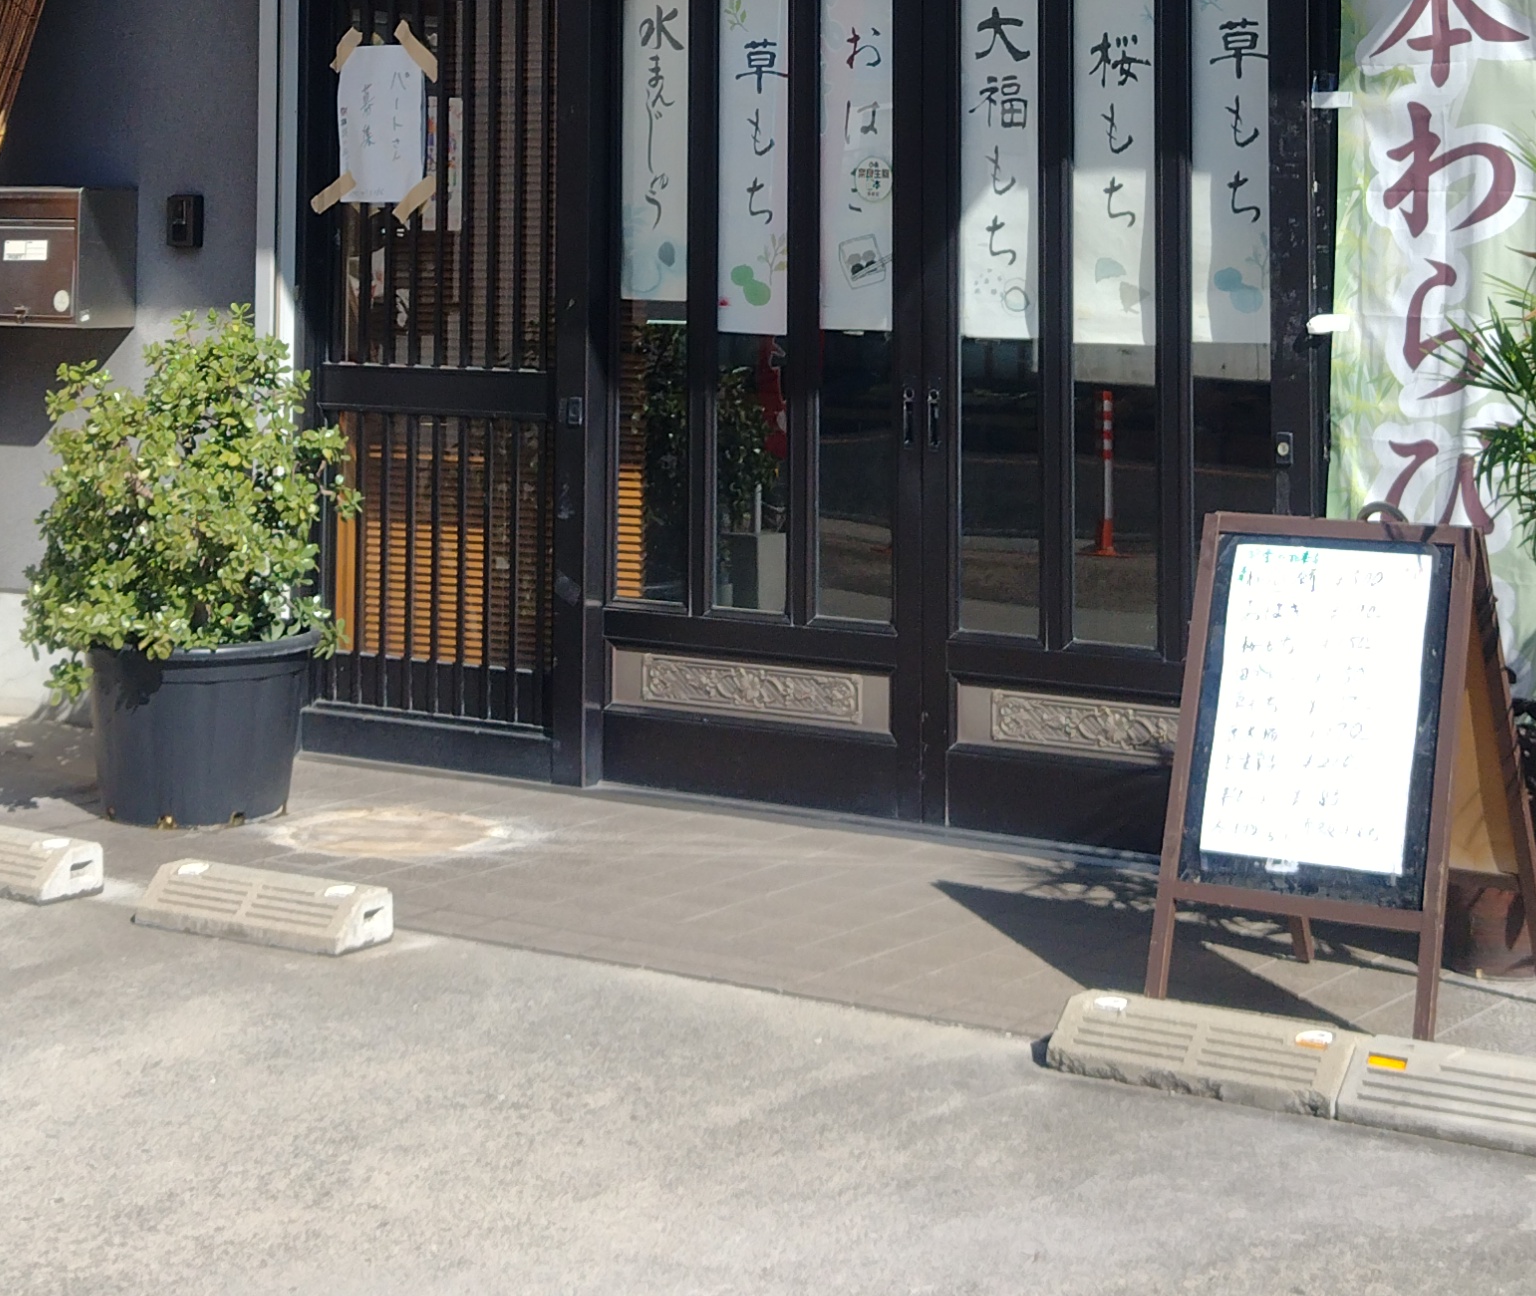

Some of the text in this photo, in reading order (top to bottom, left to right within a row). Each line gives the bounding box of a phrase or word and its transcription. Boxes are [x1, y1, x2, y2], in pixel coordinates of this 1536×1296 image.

[390, 71, 410, 161] パートさん
[639, 5, 684, 230] 水まんじゅう
[736, 39, 788, 224] 草もち
[968, 7, 1031, 265] 大福もち
[1089, 32, 1152, 227] 桜もち
[1210, 18, 1269, 223] 草もち
